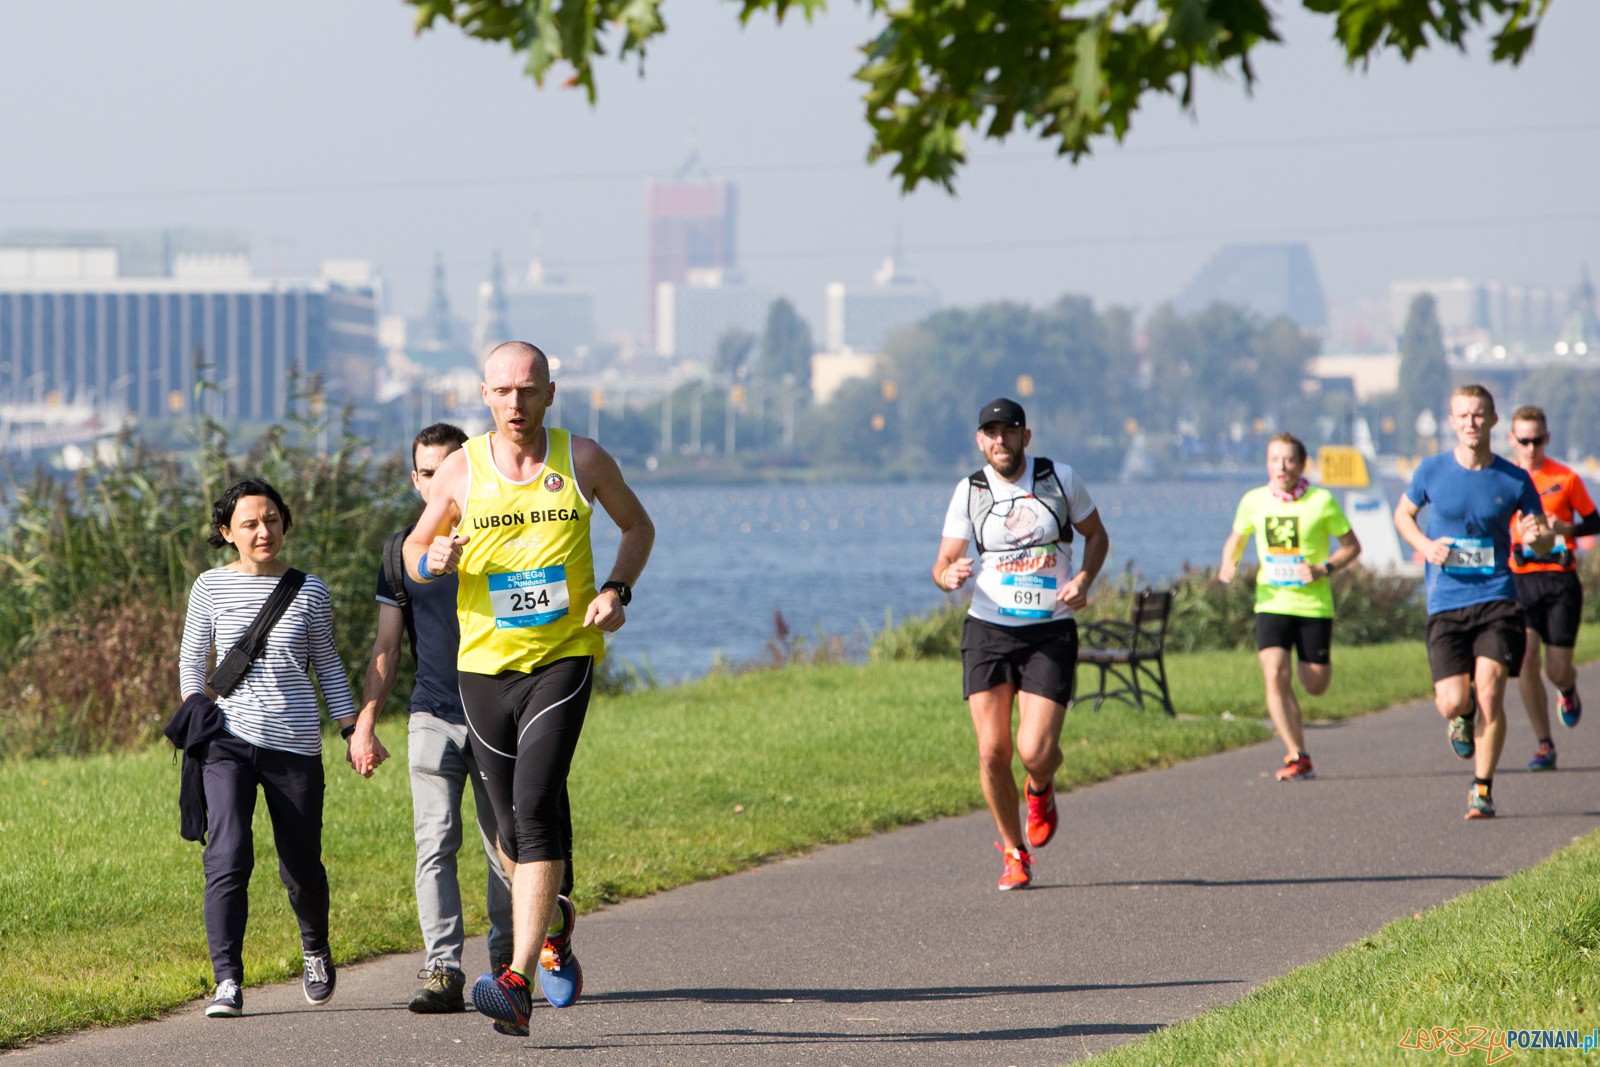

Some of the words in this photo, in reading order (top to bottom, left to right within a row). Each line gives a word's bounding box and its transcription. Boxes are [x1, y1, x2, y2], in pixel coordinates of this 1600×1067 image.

[473, 510, 525, 530] LUBOŃ
[530, 508, 580, 524] BIEGA
[1457, 551, 1482, 565] 573
[507, 569, 546, 582] zaBIEGaj
[513, 578, 547, 588] FUNdusze
[510, 589, 550, 612] 254
[1014, 590, 1041, 605] 691
